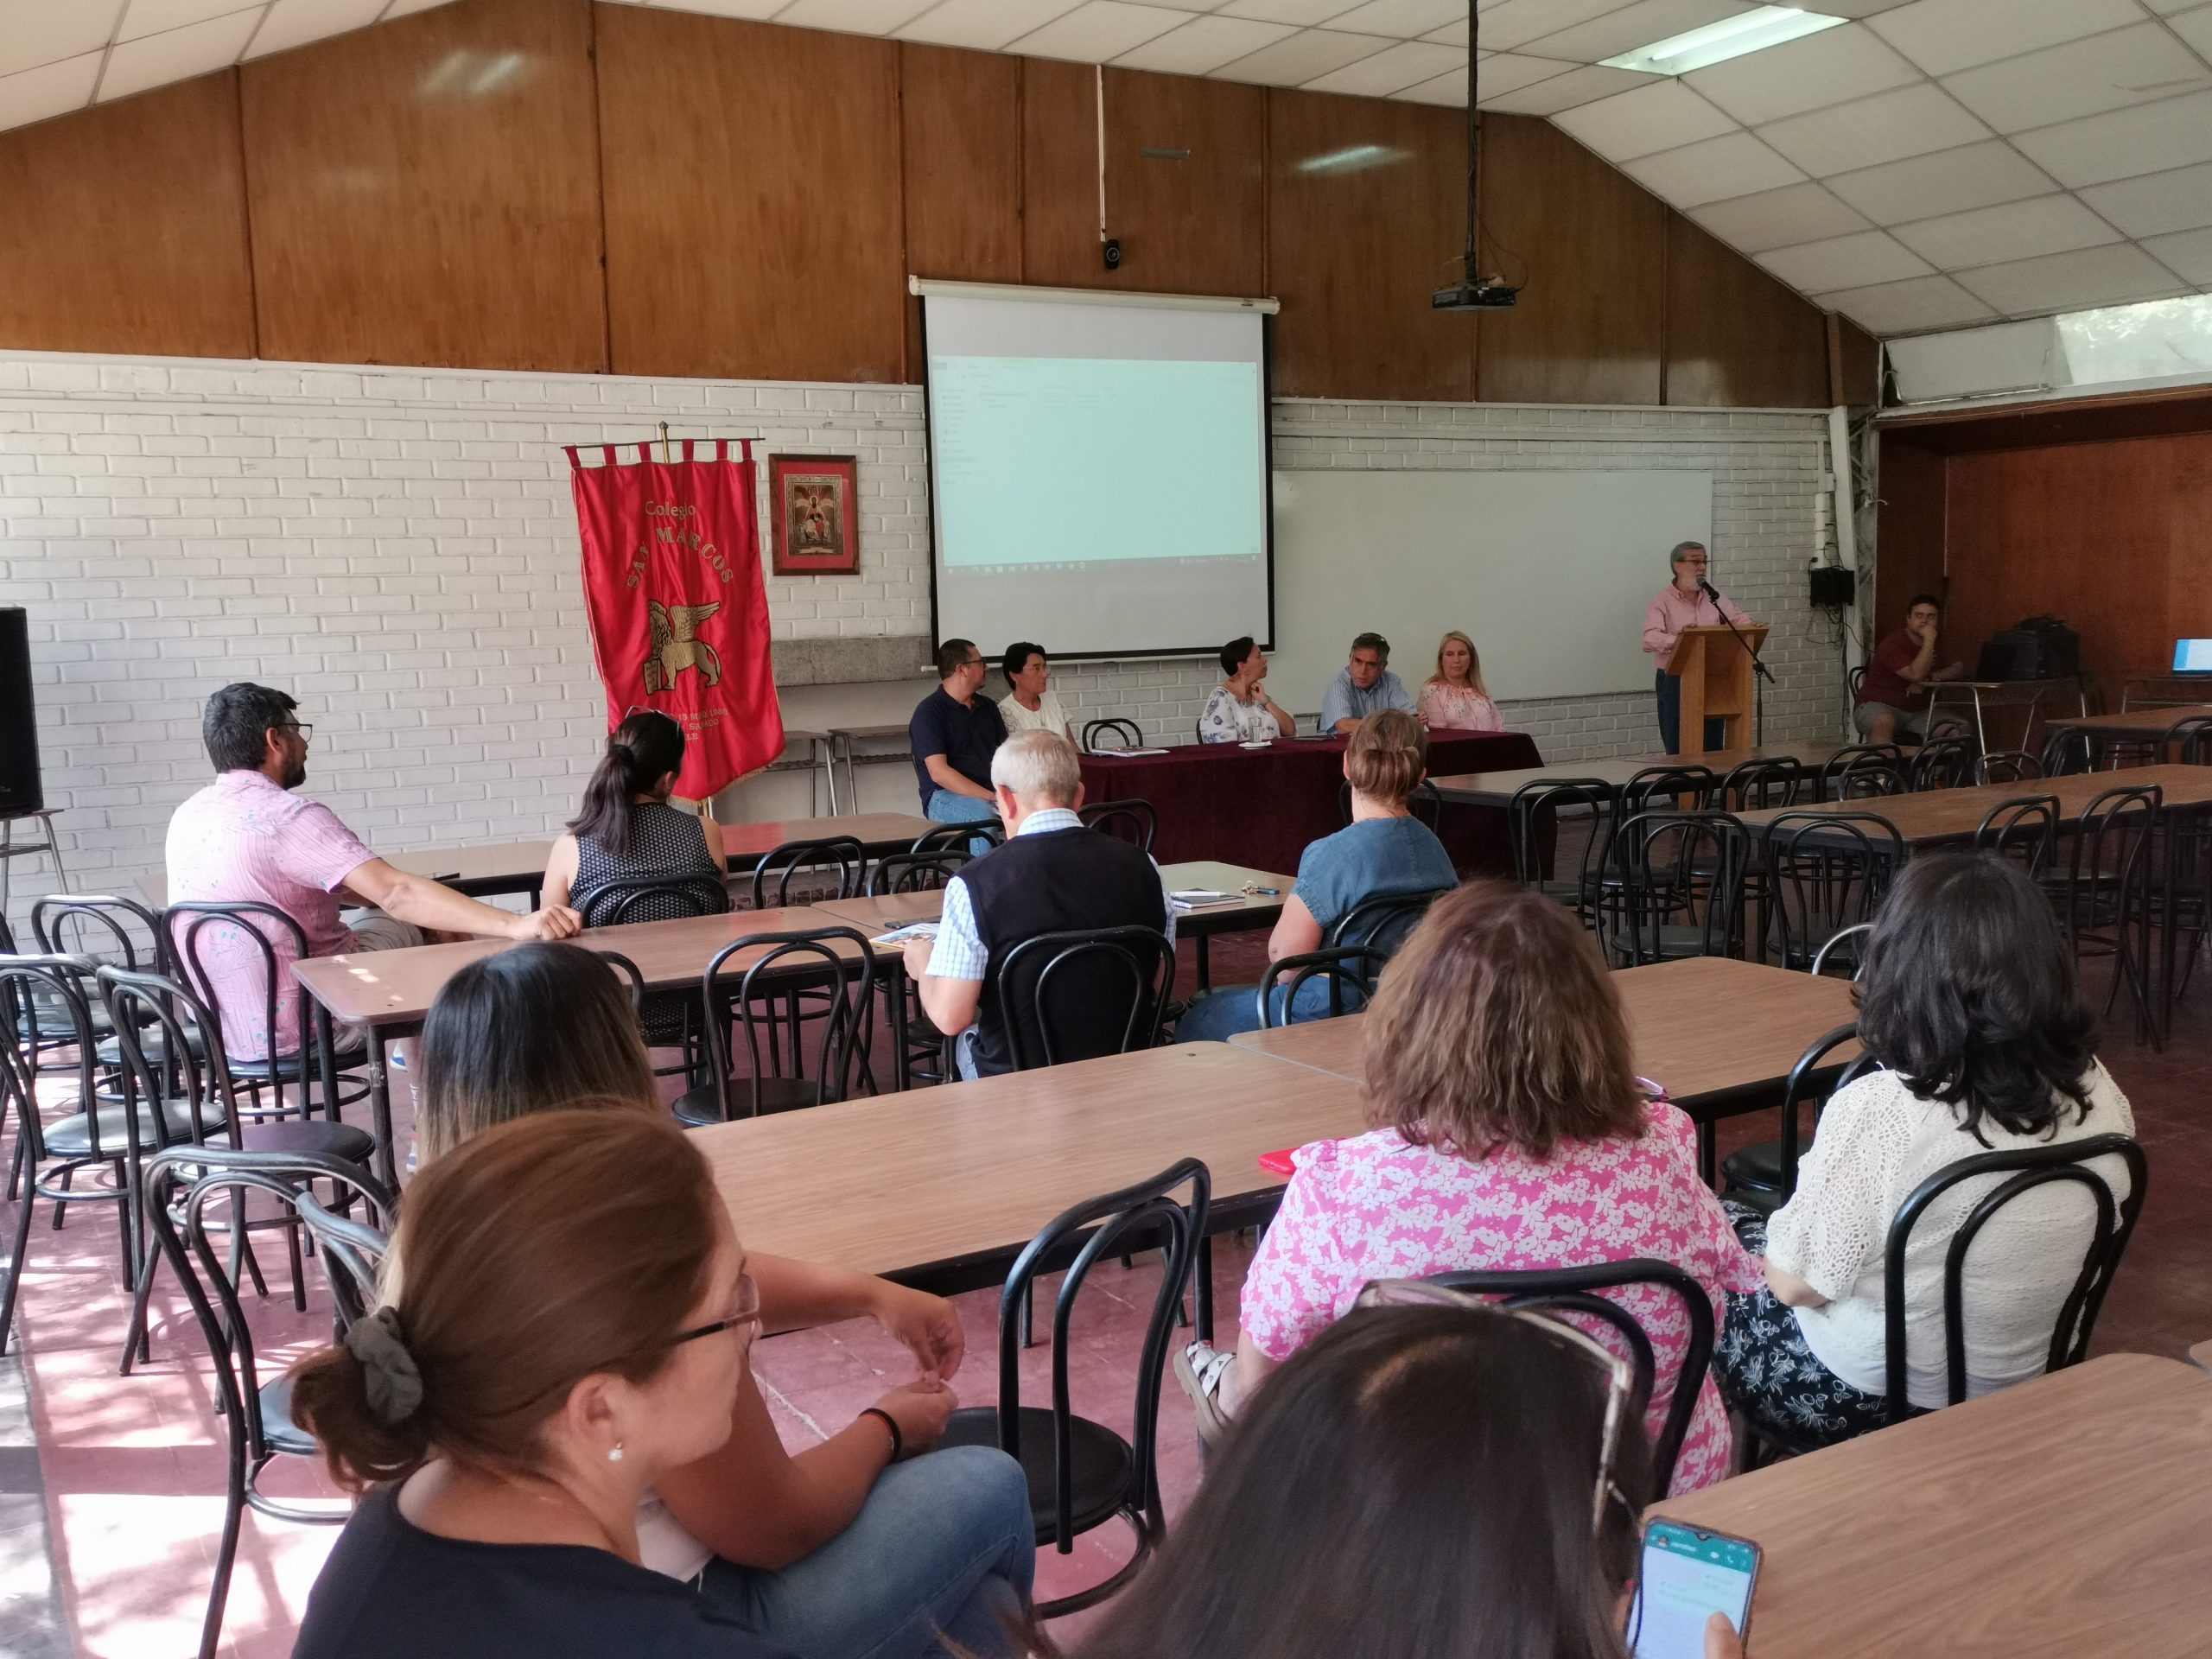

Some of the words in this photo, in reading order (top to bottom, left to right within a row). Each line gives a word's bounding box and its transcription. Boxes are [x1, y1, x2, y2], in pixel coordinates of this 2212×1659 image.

[645, 500, 696, 520] Colegio
[626, 541, 650, 588] SAN
[655, 526, 734, 584] MARCOS
